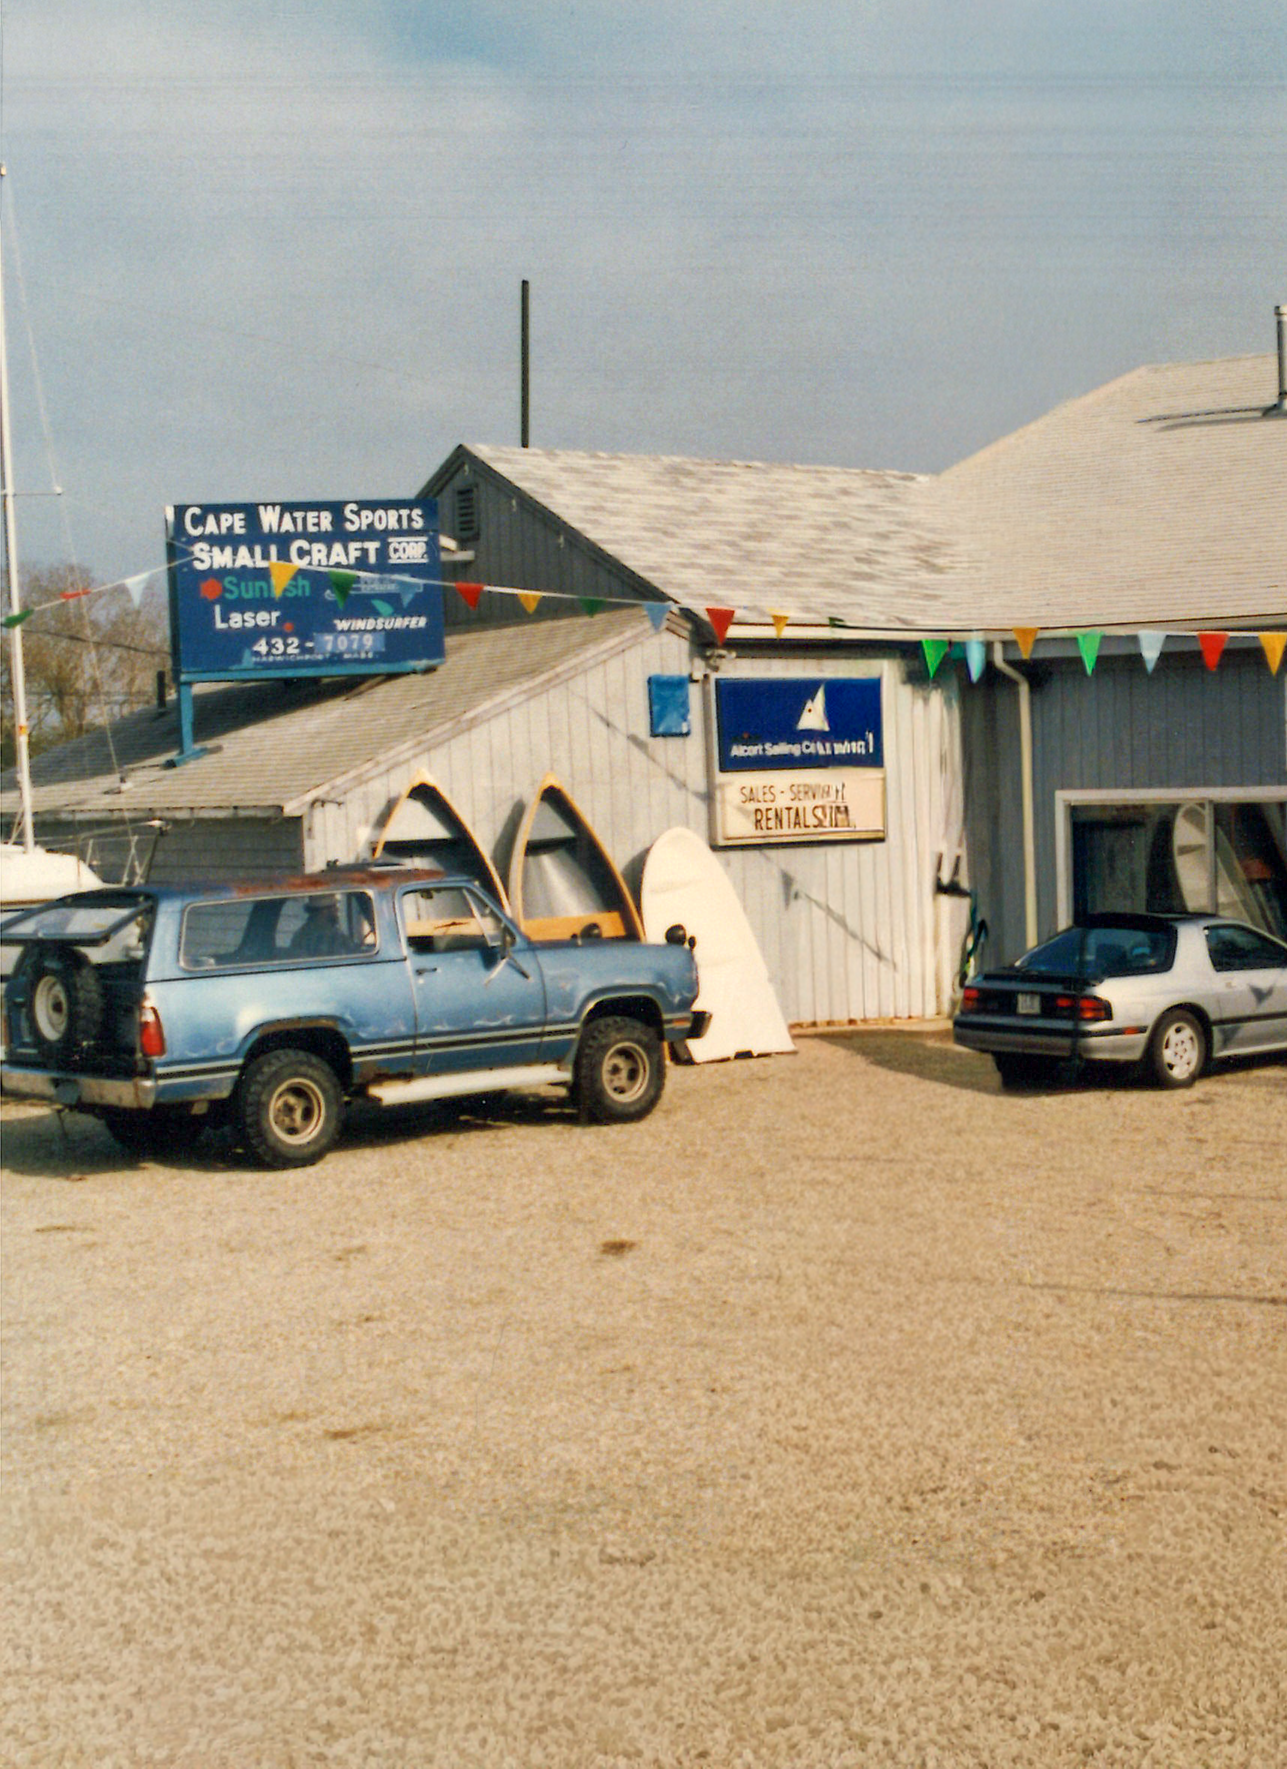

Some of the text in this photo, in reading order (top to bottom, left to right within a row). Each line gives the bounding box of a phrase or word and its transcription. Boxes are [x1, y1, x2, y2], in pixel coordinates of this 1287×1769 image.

[223, 575, 310, 599] Sunsh
[214, 604, 281, 629] Laser
[333, 616, 428, 631] WINDSURFER
[740, 785, 776, 804] SALES
